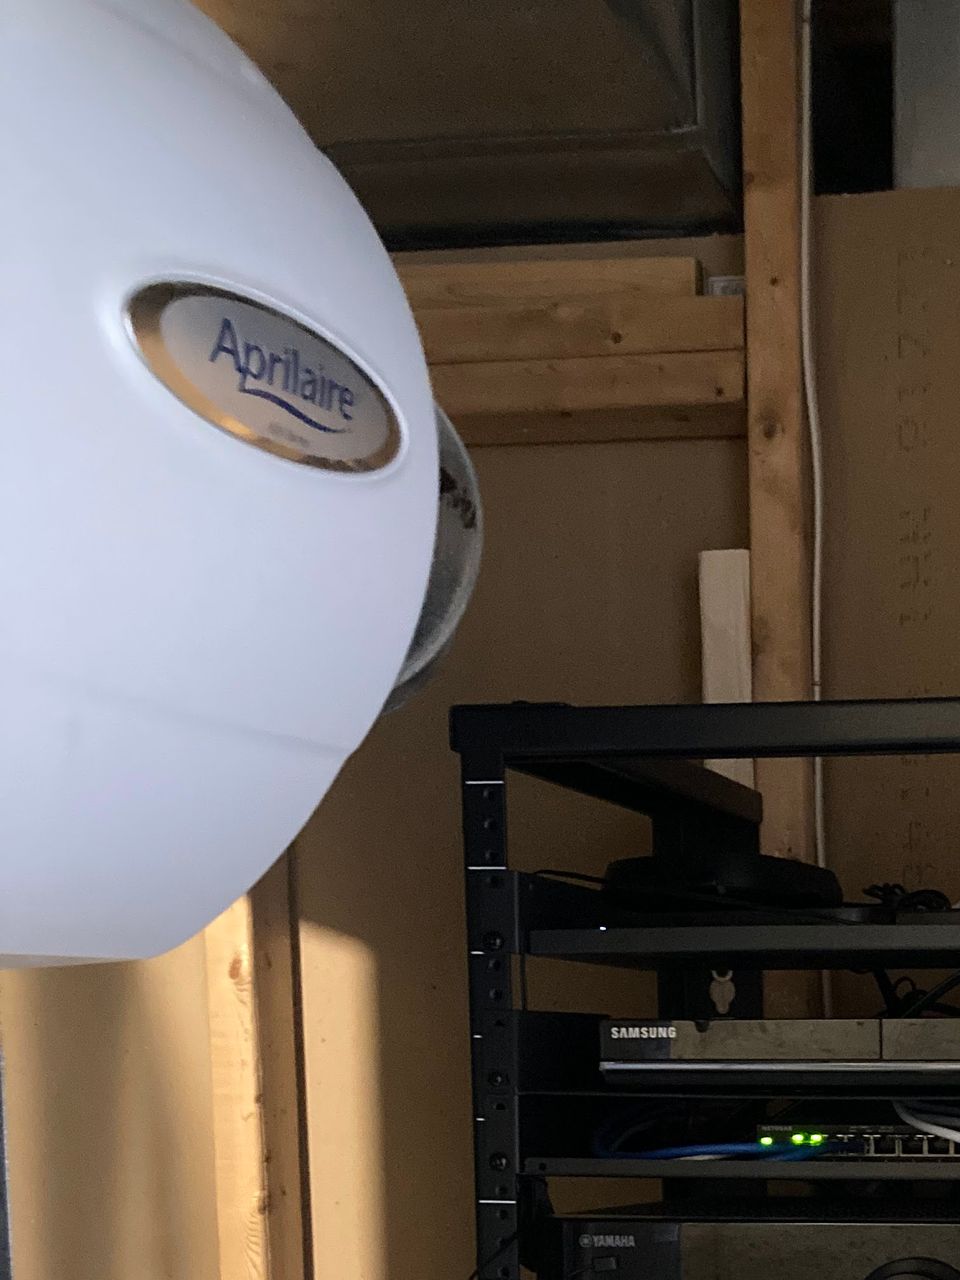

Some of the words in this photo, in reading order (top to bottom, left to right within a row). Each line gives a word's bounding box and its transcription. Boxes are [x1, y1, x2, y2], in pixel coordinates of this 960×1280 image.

[208, 317, 354, 421] Aprilaire
[611, 1027, 676, 1038] SAMSUNG
[592, 1235, 635, 1247] YAMAHA
